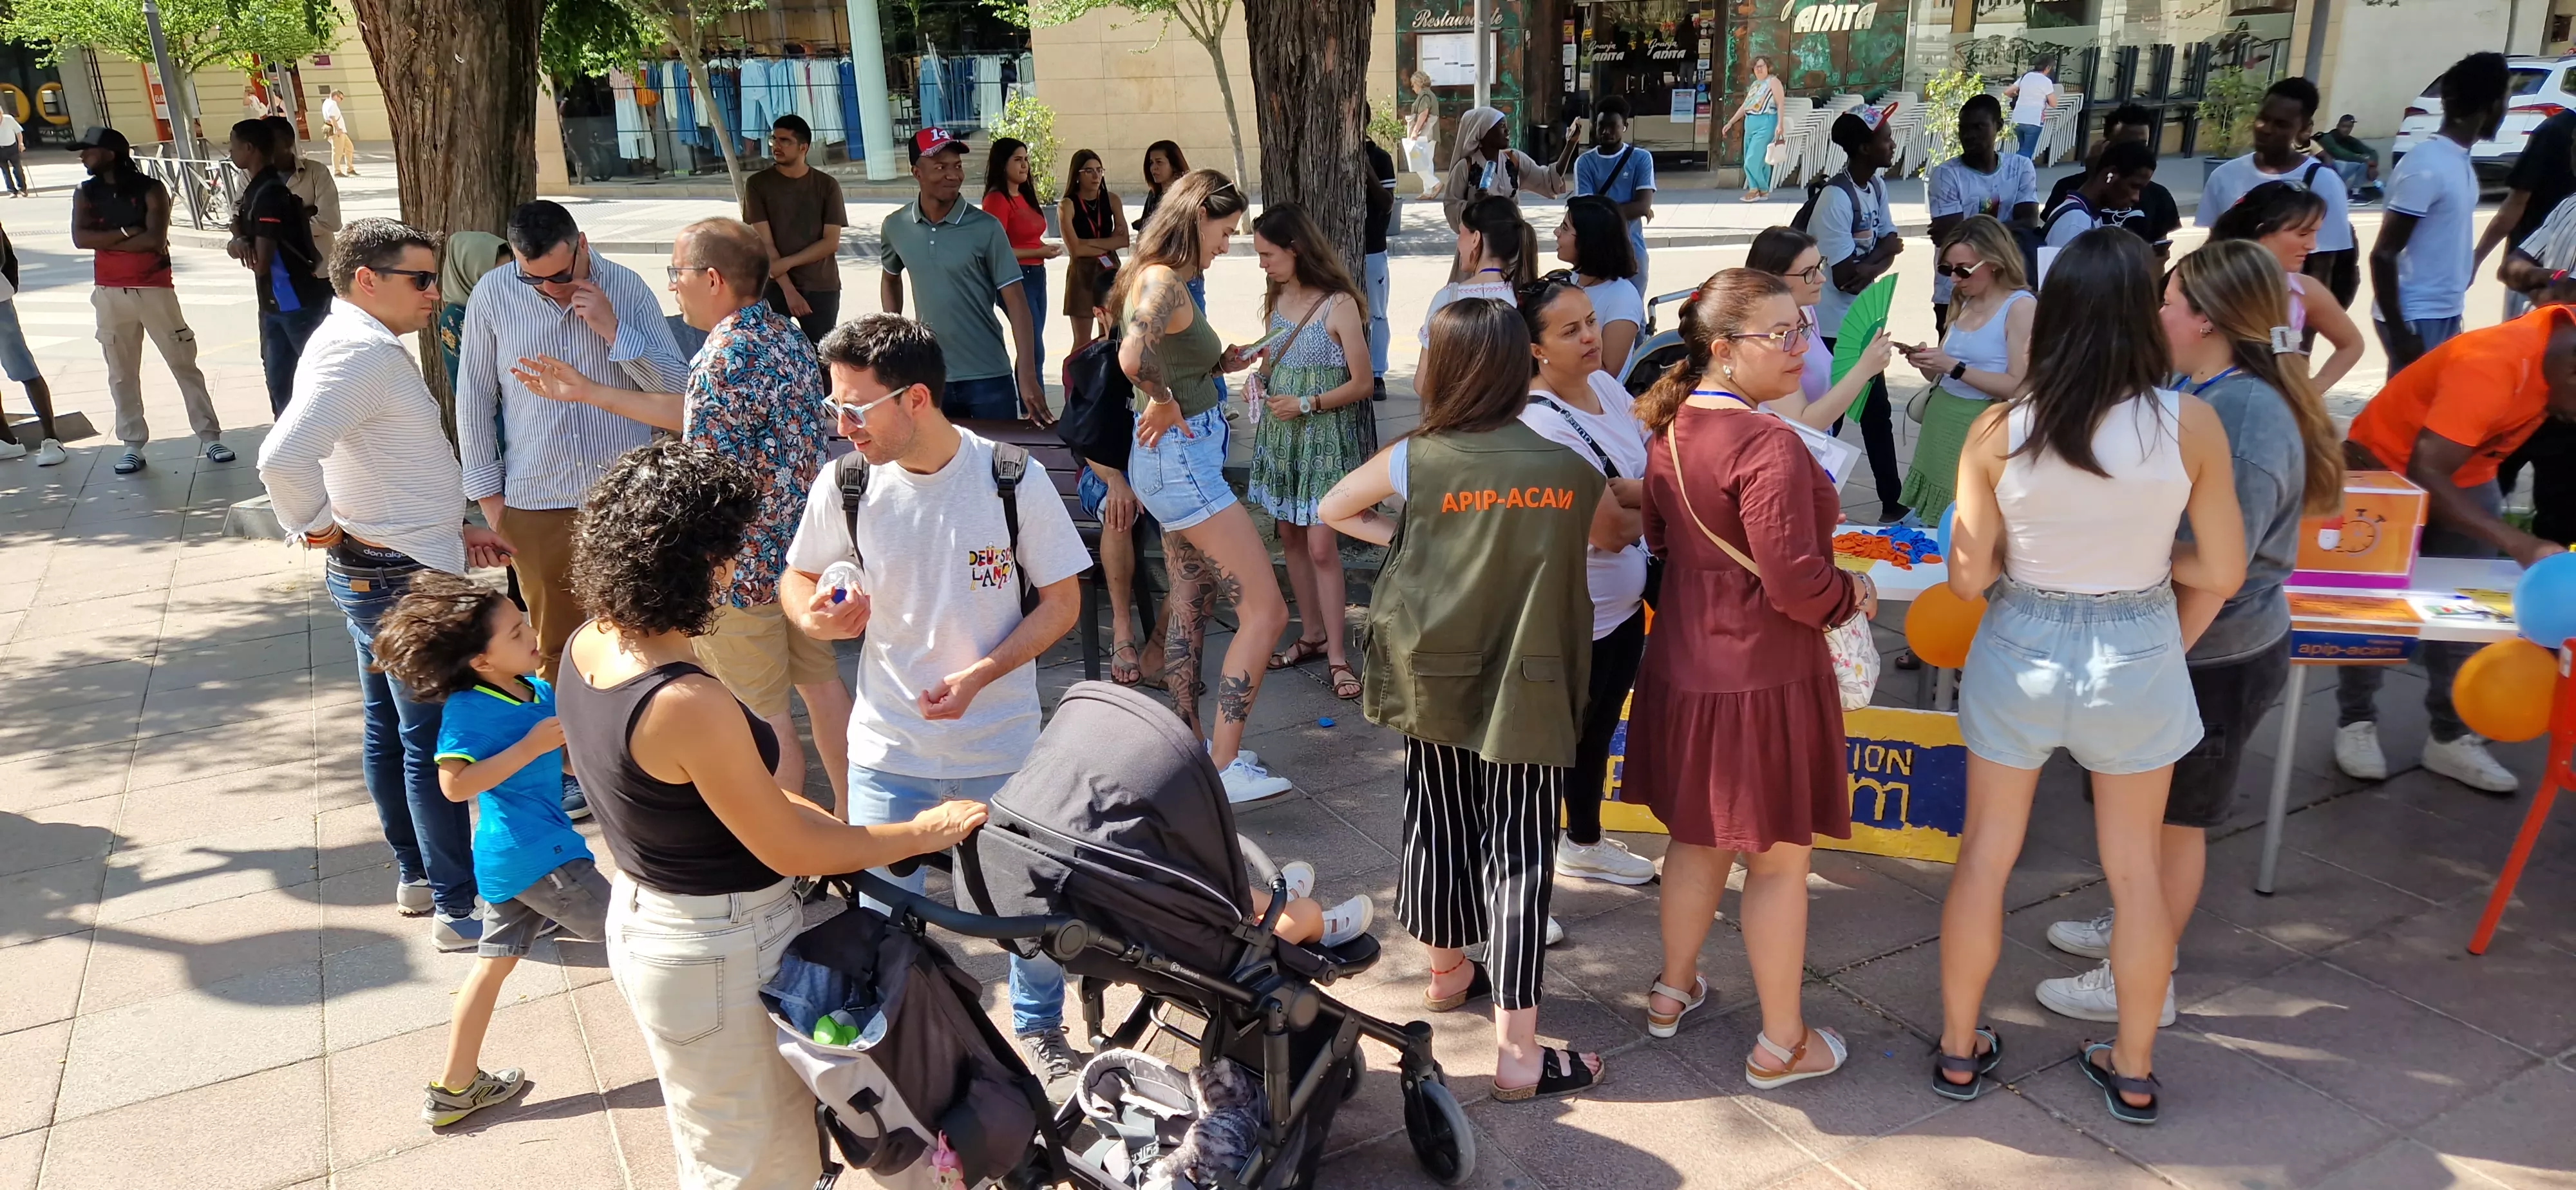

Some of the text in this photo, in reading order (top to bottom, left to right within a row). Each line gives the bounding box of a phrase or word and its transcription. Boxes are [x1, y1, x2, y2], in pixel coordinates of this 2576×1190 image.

[1412, 7, 1504, 28] Restaurate
[1794, 3, 1878, 32] ANITA
[1592, 52, 1625, 61] ANITA
[1653, 50, 1687, 59] ANITA
[931, 128, 951, 141] 14
[363, 549, 383, 558] don
[2297, 642, 2401, 657] apip-acam
[1845, 742, 1912, 775] ION
